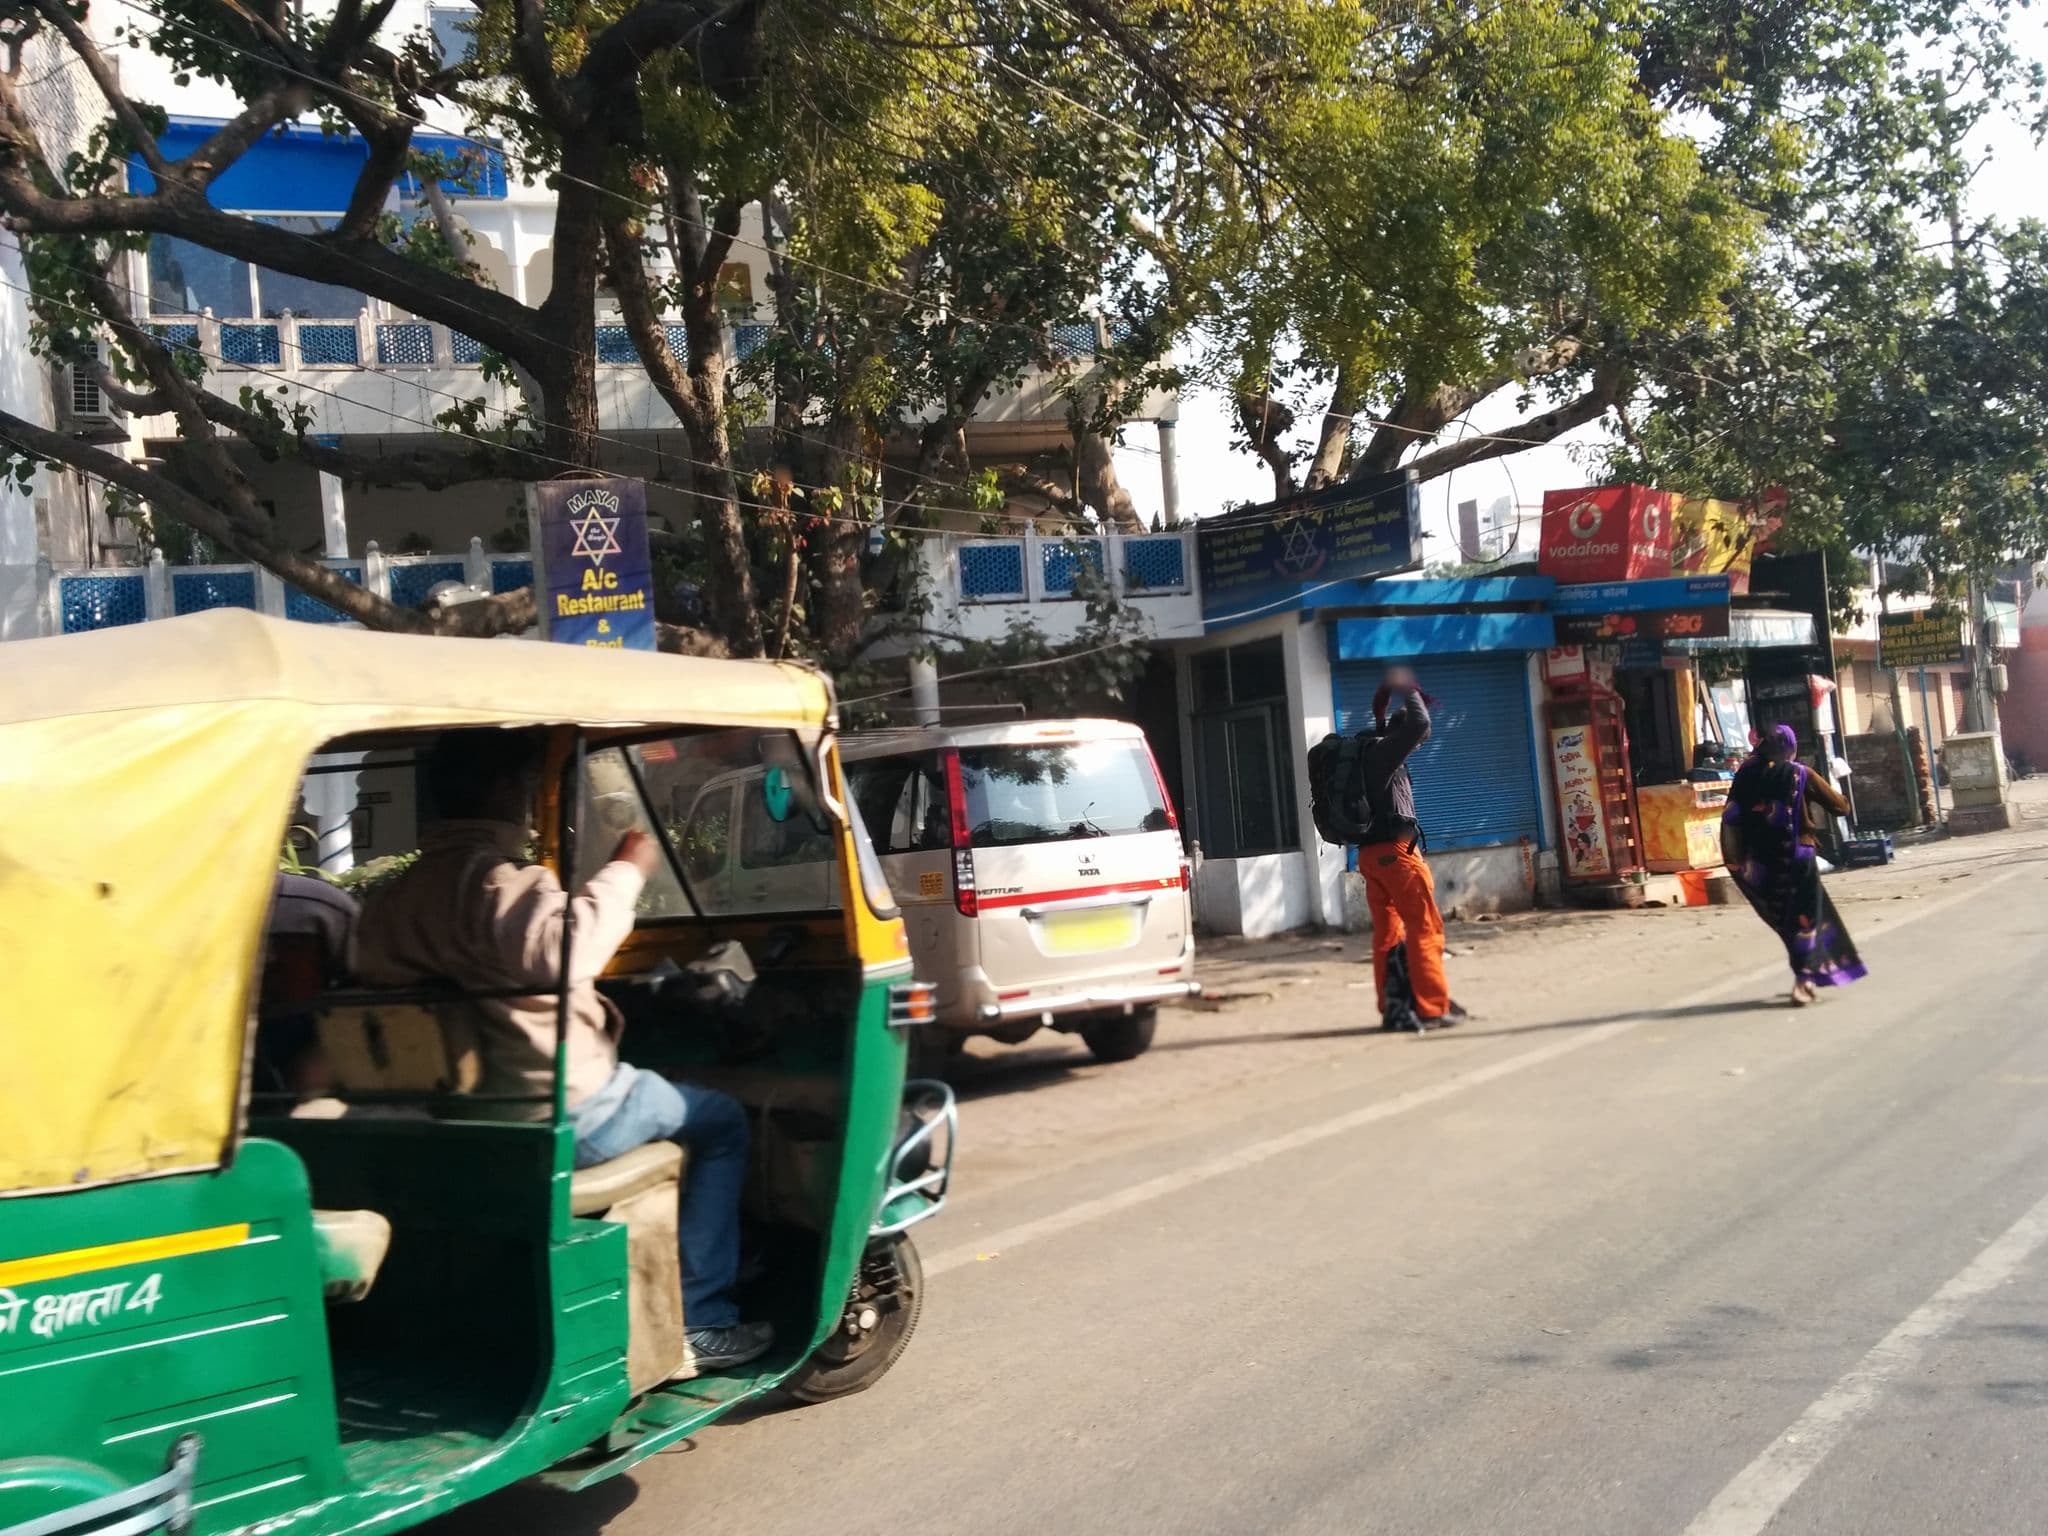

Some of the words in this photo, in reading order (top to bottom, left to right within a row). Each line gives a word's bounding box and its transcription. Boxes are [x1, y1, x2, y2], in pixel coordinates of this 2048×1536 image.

[567, 490, 619, 513] MAYA
[1549, 541, 1619, 558] vodafone
[582, 568, 618, 591] A/c
[557, 589, 645, 616] Restaurant
[598, 618, 611, 634] &
[1078, 868, 1101, 877] TATA
[976, 887, 1024, 896] VENTURE
[125, 1273, 163, 1315] 4
